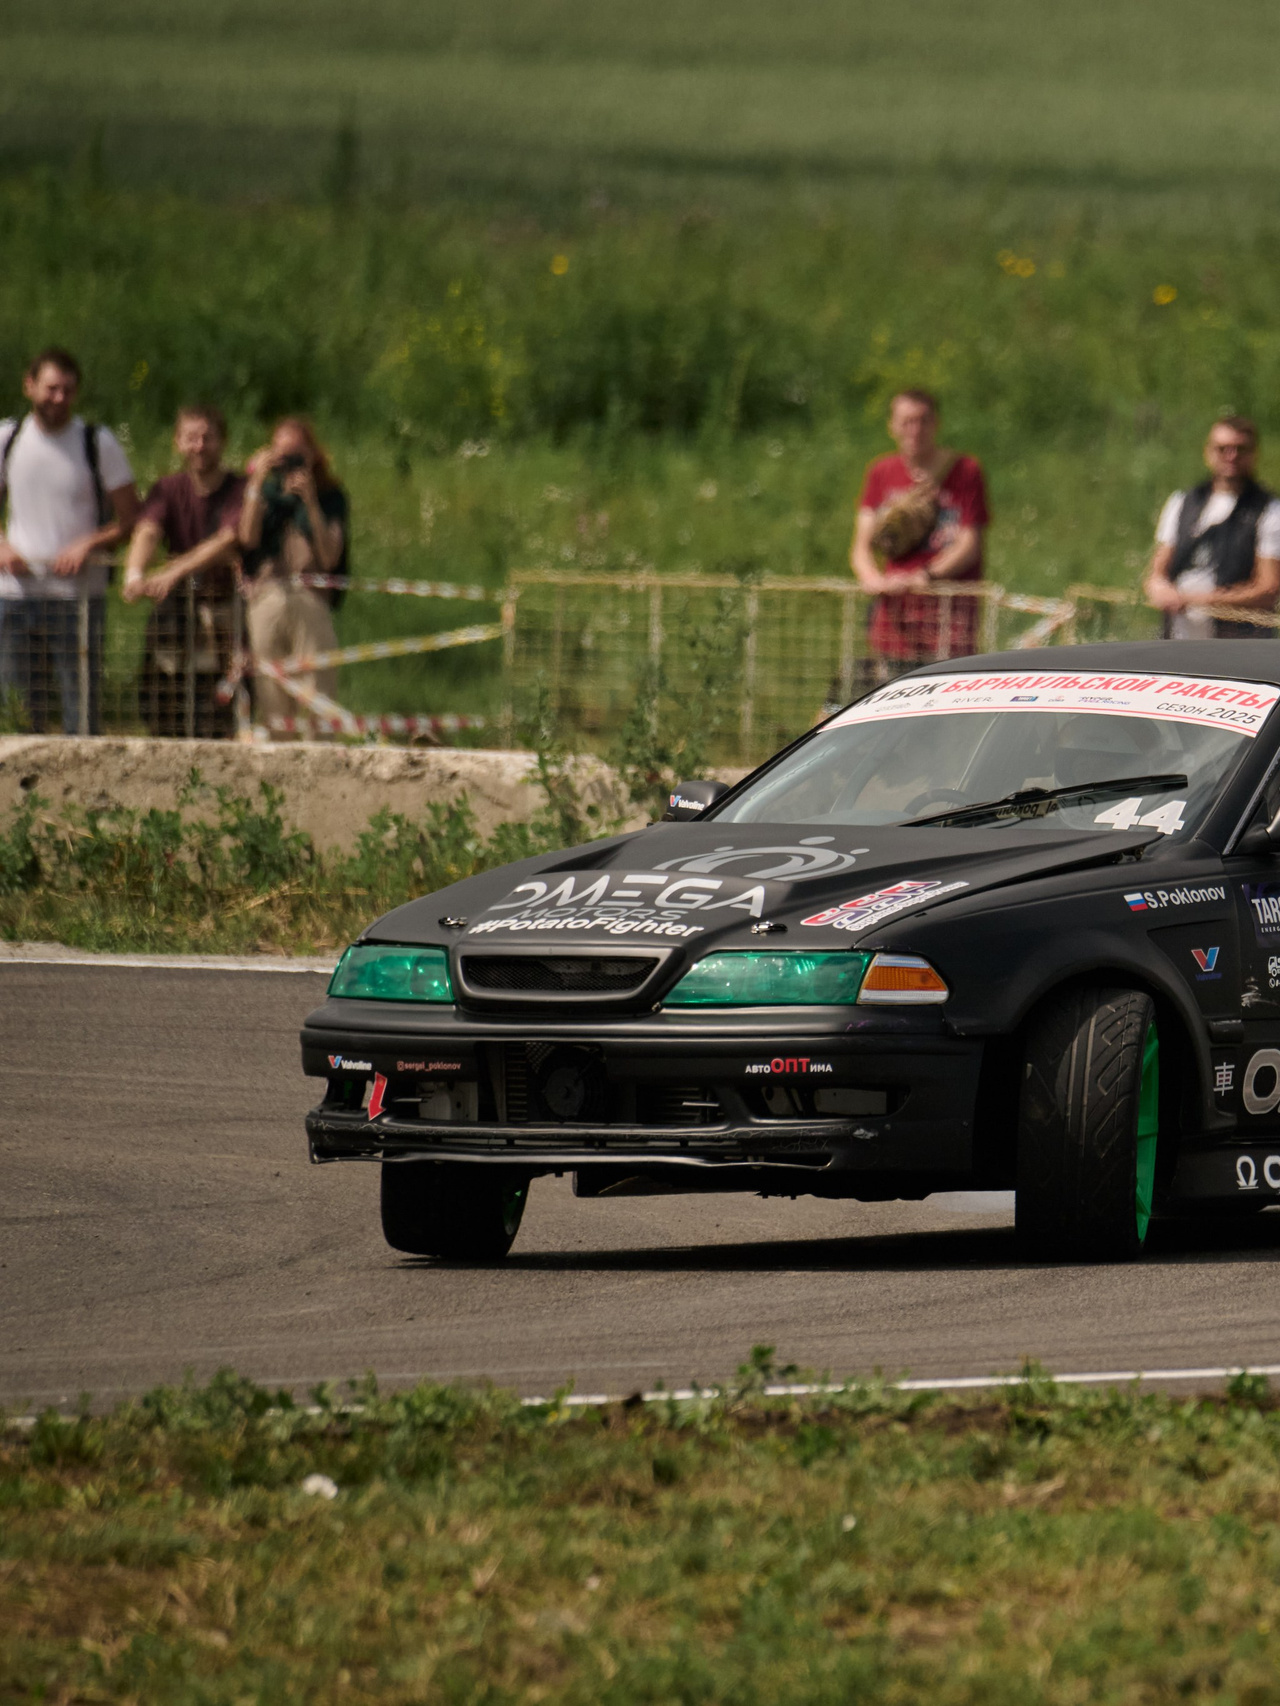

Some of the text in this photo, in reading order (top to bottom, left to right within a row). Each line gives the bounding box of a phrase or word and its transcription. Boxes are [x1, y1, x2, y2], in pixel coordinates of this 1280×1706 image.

[940, 675, 1160, 694] БАРНАУЛЬСКОЙ
[1154, 681, 1278, 710] РАКЕТЫ
[1156, 702, 1262, 725] СЕЗОН 2025
[1093, 797, 1188, 836] 44
[489, 874, 766, 918] OMEGA
[1143, 886, 1227, 910] S.Poklonov
[509, 907, 689, 922] MOTORS
[467, 916, 705, 938] #PotatoFighter
